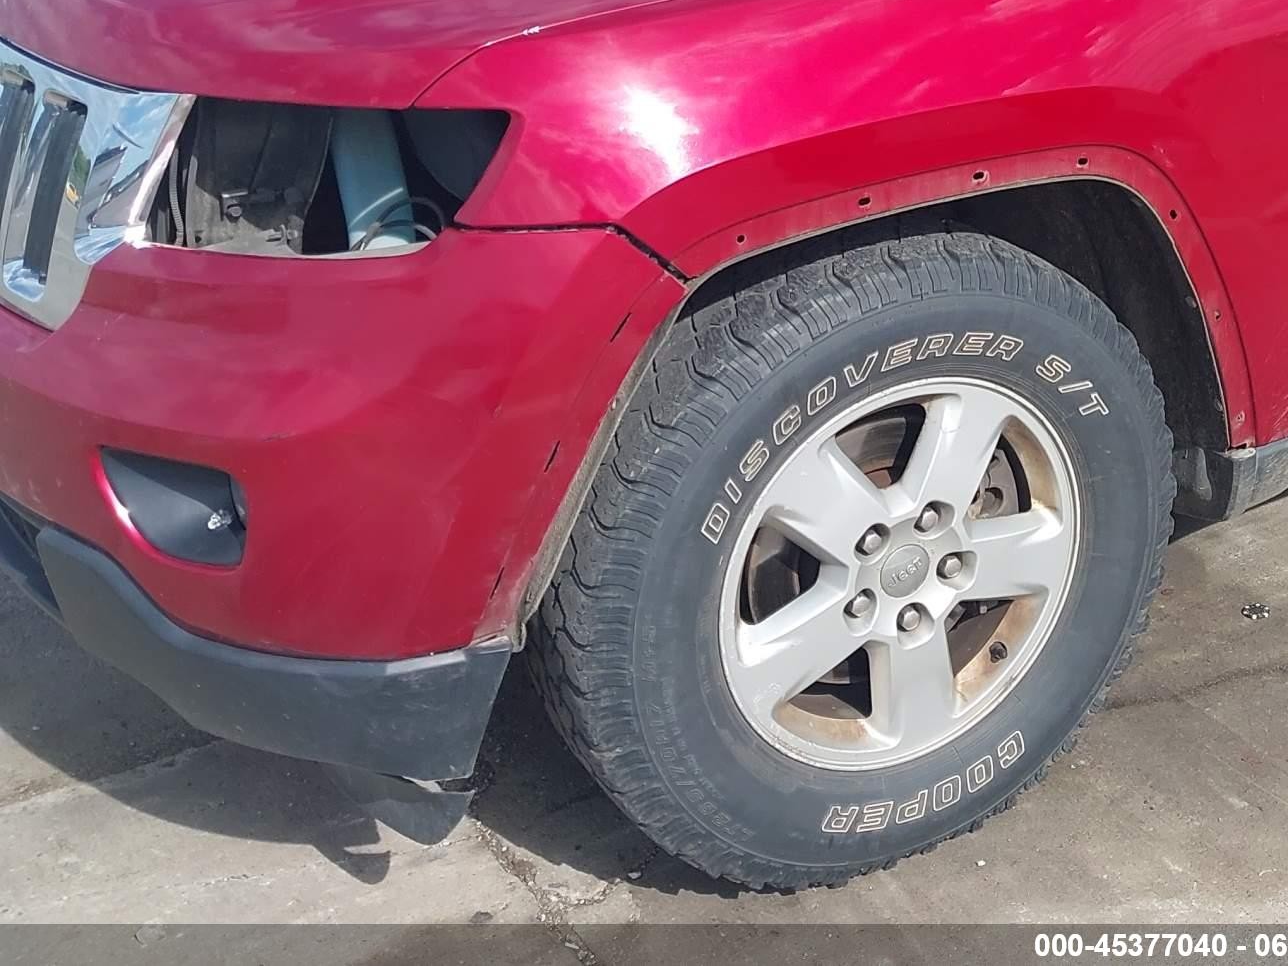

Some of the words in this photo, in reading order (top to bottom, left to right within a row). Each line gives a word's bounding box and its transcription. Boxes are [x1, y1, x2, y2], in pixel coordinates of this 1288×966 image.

[701, 332, 1024, 544] DISCOVERER
[1036, 354, 1110, 416] S/T
[821, 730, 1025, 833] COOPER
